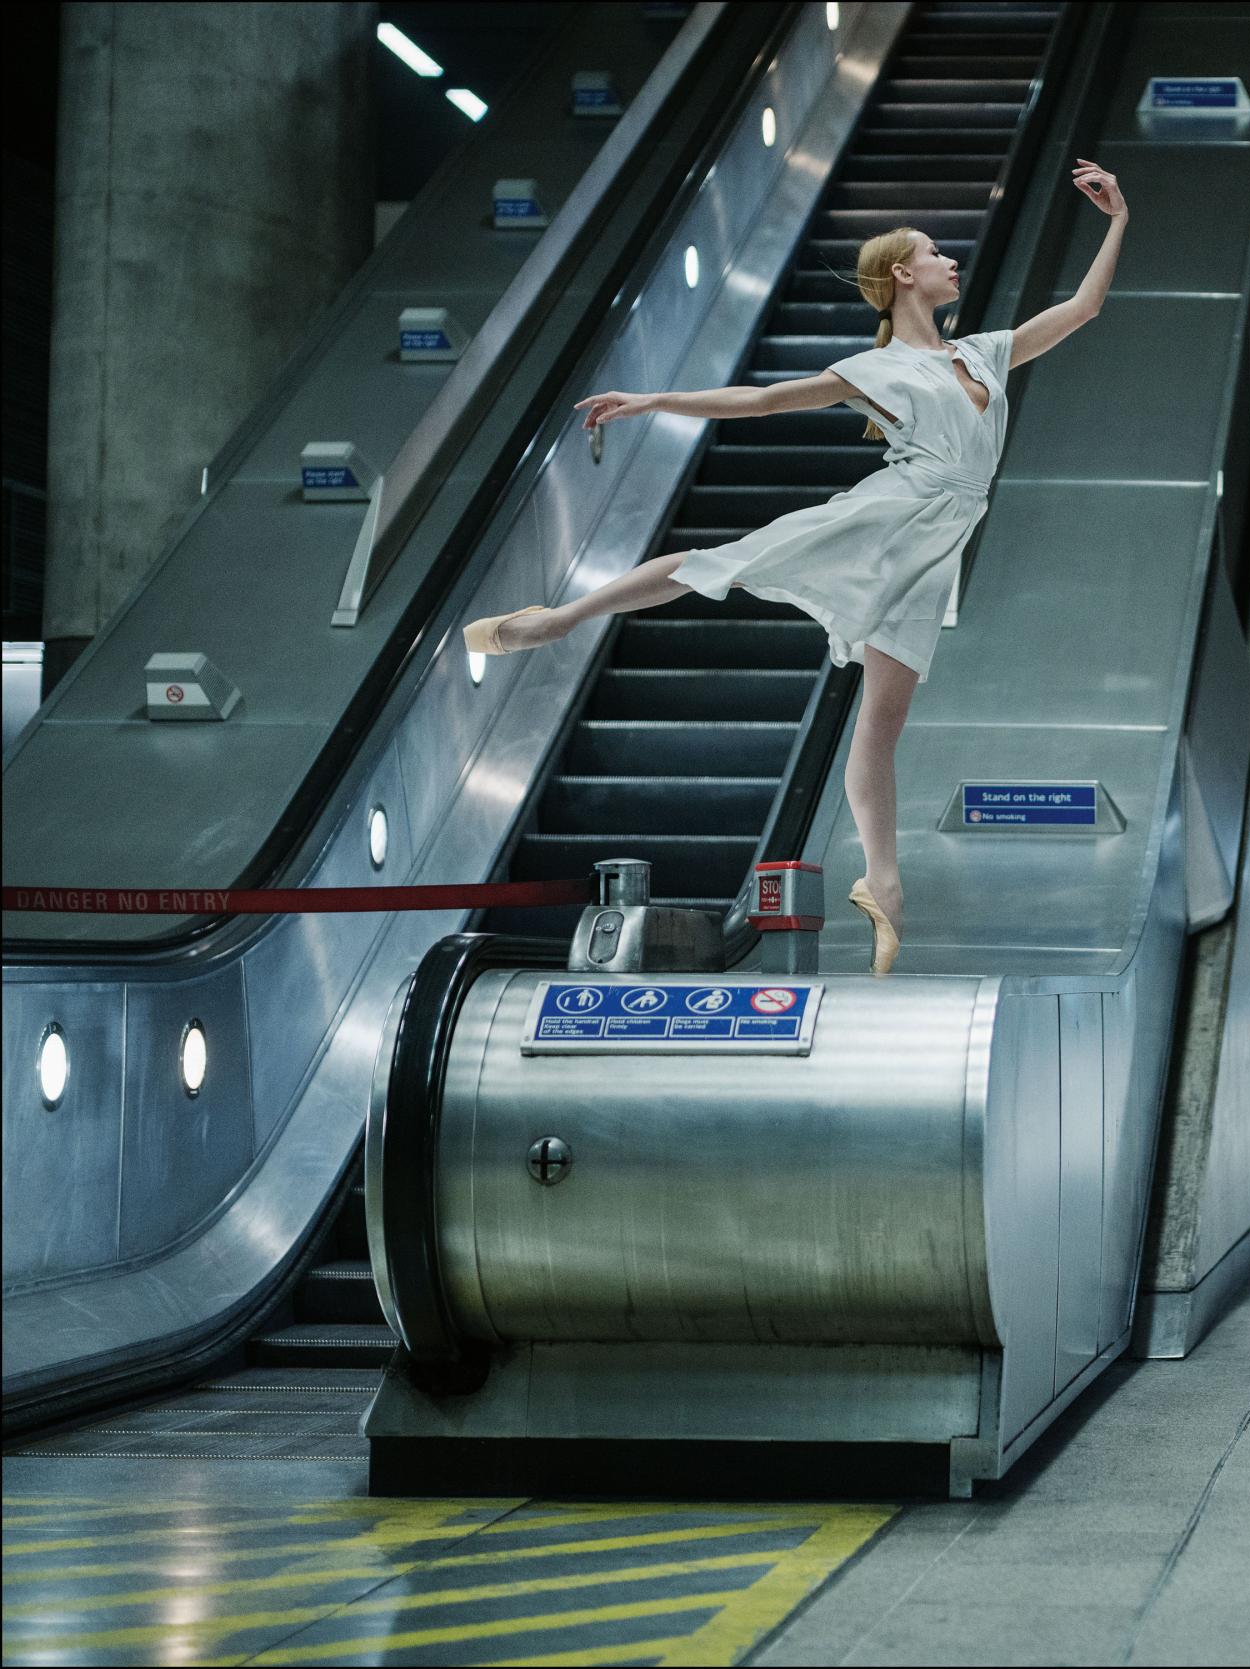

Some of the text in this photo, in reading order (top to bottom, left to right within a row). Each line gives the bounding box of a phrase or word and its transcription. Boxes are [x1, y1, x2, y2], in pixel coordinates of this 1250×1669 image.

[982, 792, 1072, 804] Stand on the right
[996, 812, 1026, 822] smoking
[17, 890, 230, 911] DANGER NO ENTRY
